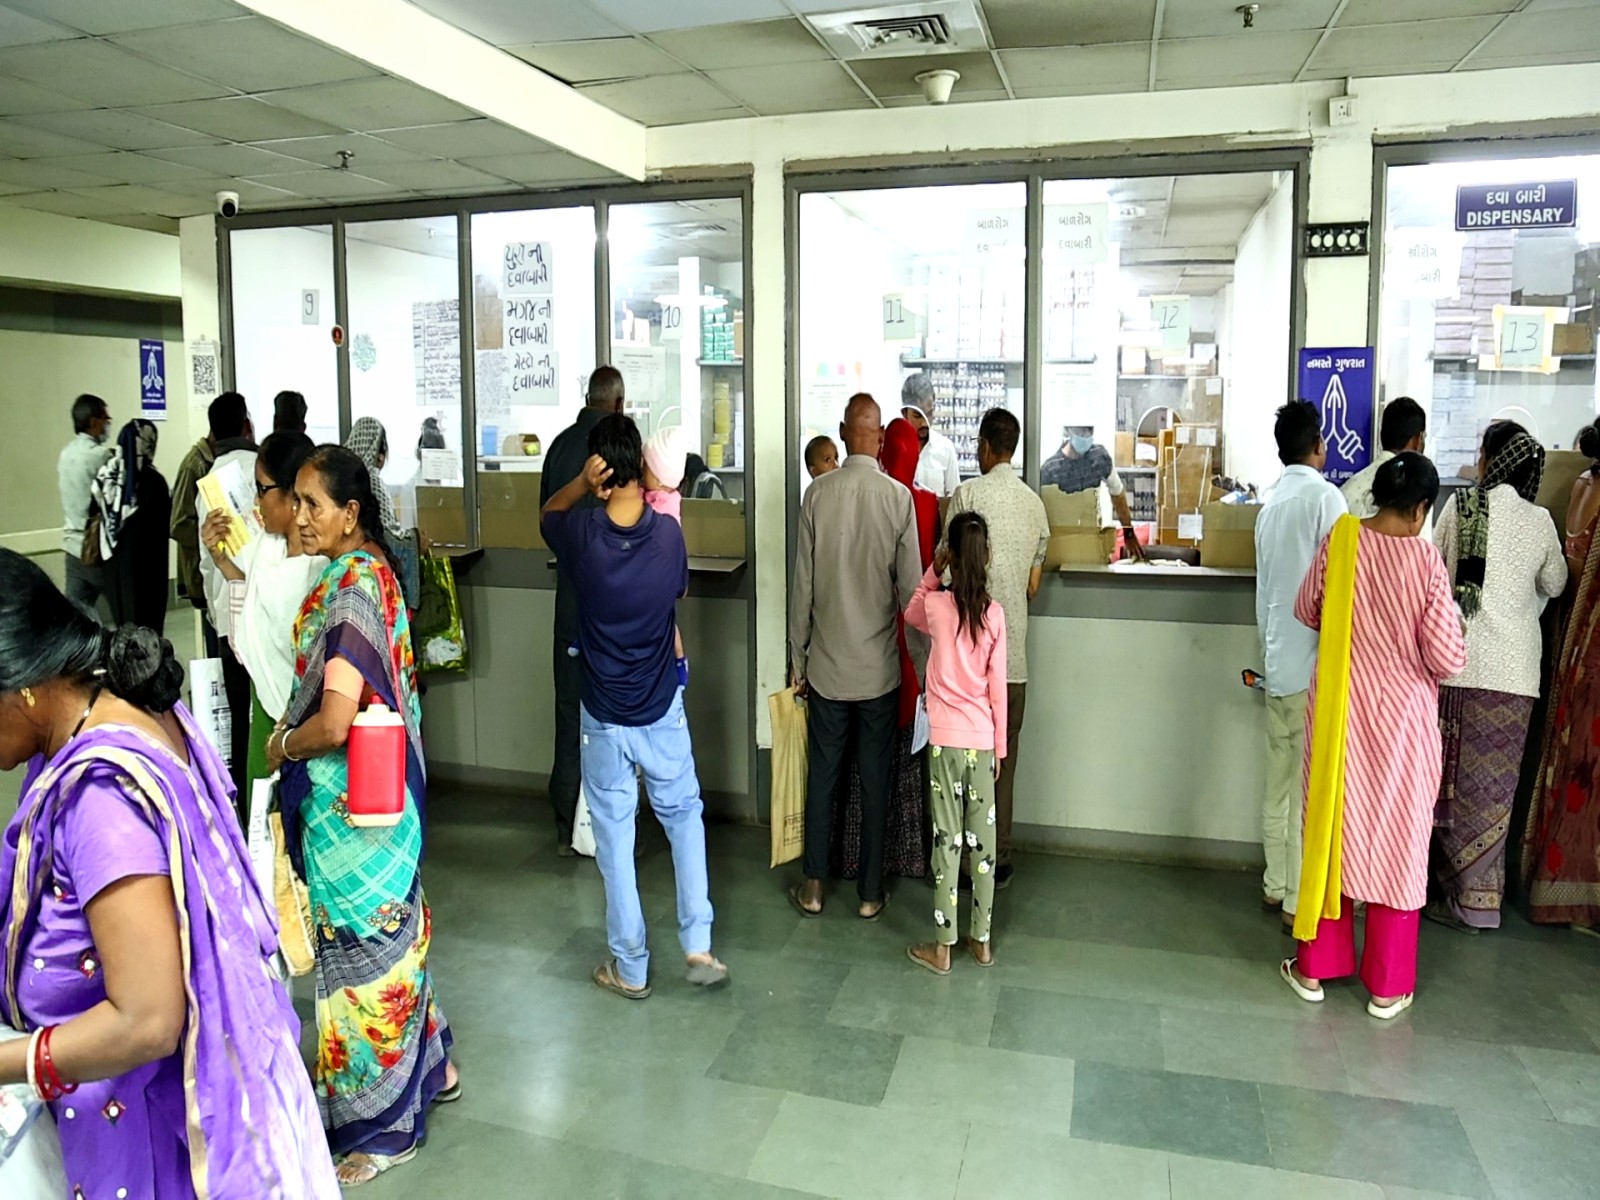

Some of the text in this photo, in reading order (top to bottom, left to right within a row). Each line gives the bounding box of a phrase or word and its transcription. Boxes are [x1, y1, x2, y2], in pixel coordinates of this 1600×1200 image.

[1486, 184, 1546, 205] દવા બારી
[1058, 212, 1092, 226] બાળરોગ
[1466, 207, 1564, 226] DISPENSARY
[305, 293, 313, 316] 9
[885, 299, 905, 323] 11
[664, 305, 681, 329] 10
[1160, 305, 1179, 330] 12
[1504, 321, 1539, 354] 13
[1306, 355, 1365, 372] નમસ્તે ગુજરાત
